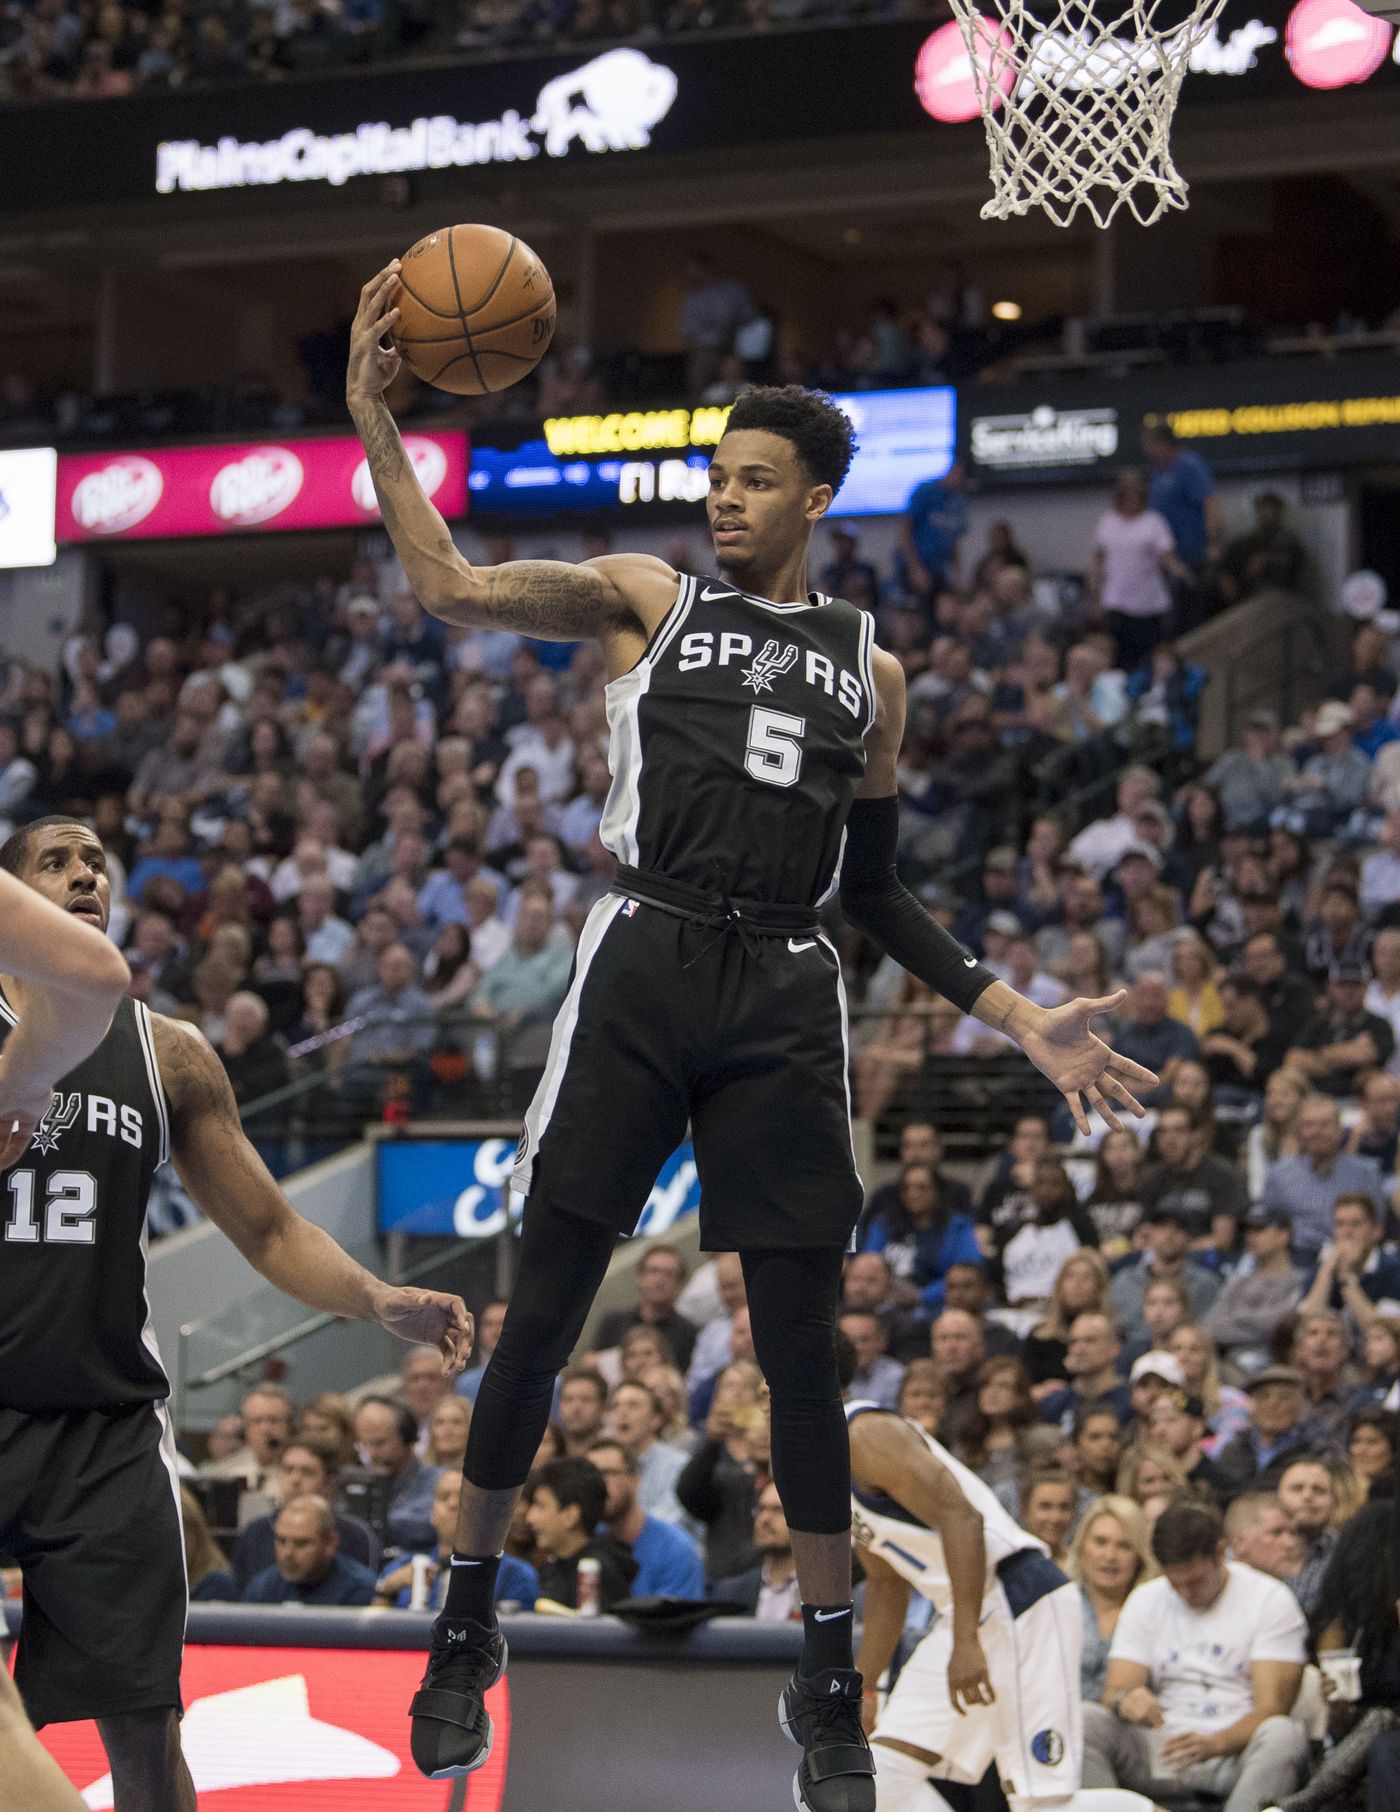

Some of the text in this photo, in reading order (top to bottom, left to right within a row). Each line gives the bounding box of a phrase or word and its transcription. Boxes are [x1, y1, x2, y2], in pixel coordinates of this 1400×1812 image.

[544, 409, 690, 455] WELCOME
[678, 632, 862, 719] SPURS
[744, 704, 806, 788] 5
[4, 1168, 98, 1244] 12
